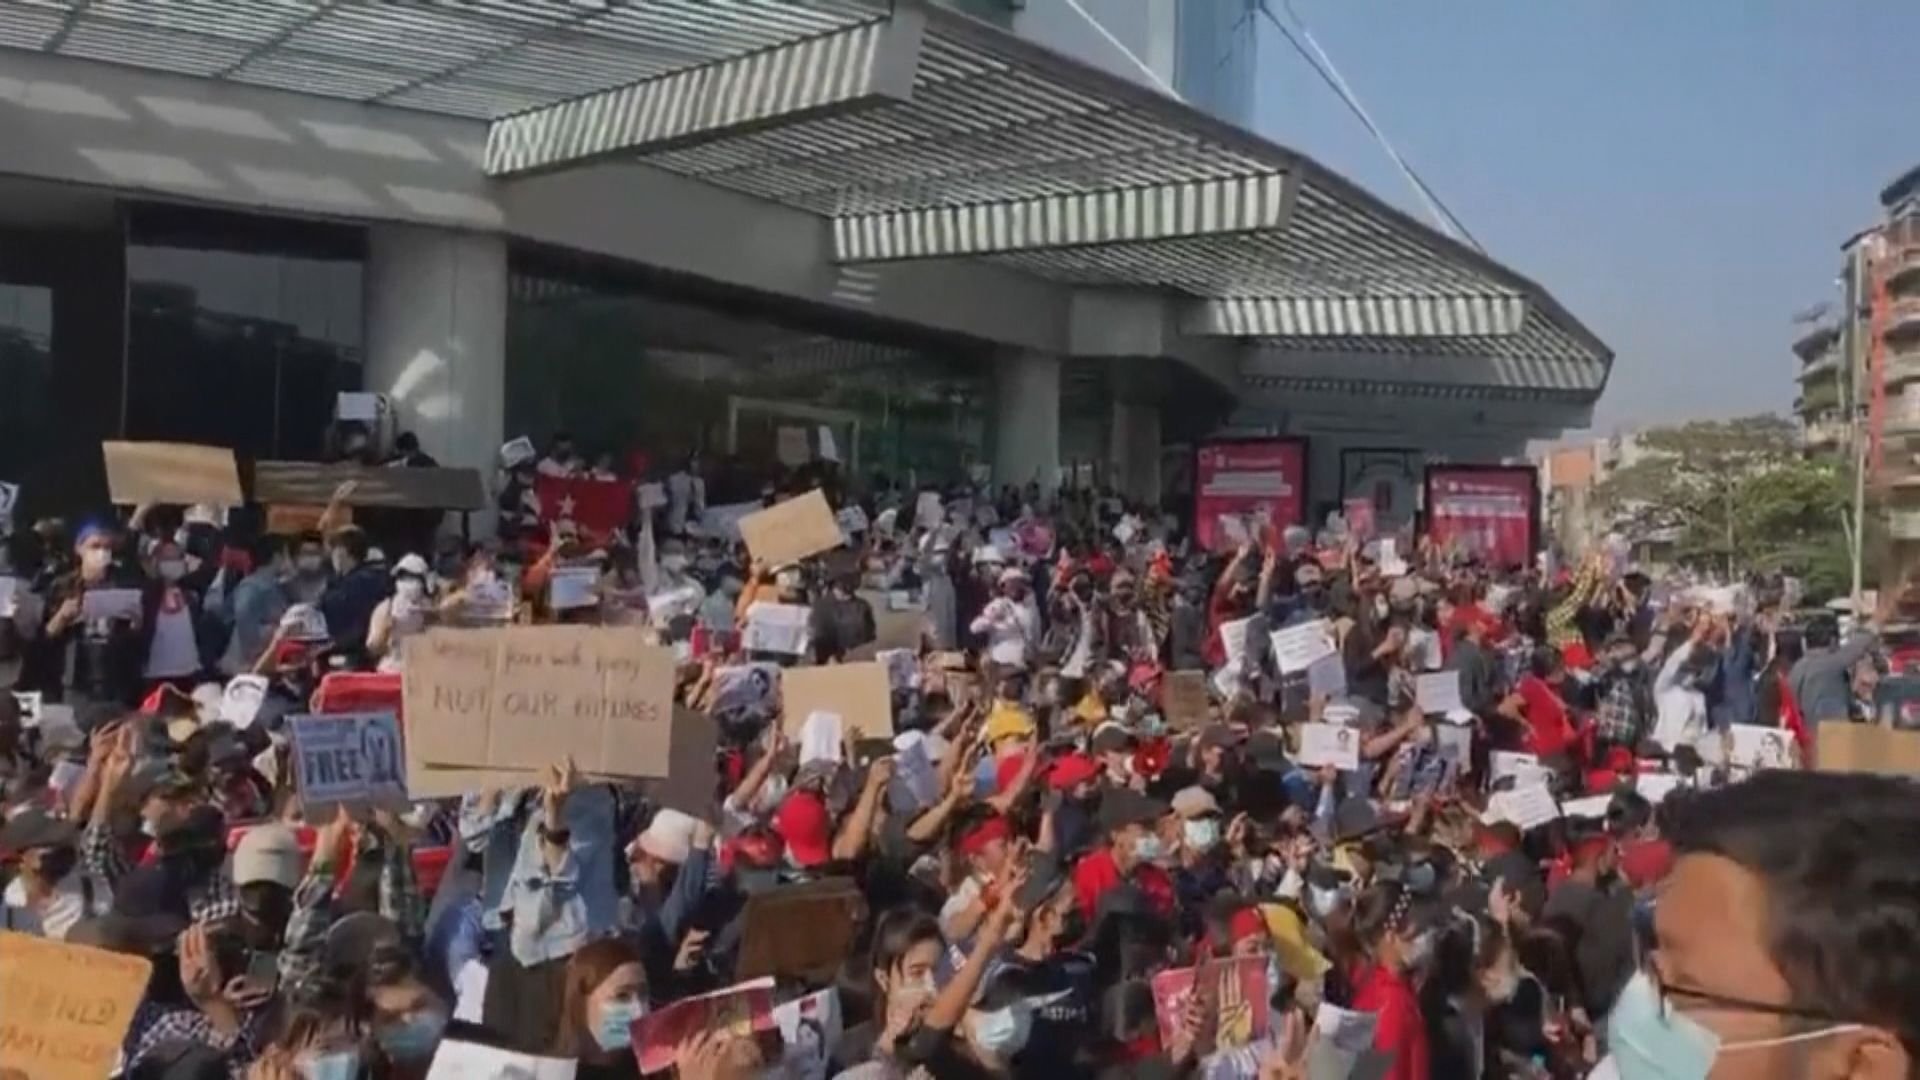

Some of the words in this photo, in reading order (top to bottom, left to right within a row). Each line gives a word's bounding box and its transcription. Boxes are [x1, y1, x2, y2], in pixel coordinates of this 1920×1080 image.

[433, 685, 486, 715] NOT
[502, 690, 559, 717] OUR
[304, 748, 362, 786] FREE
